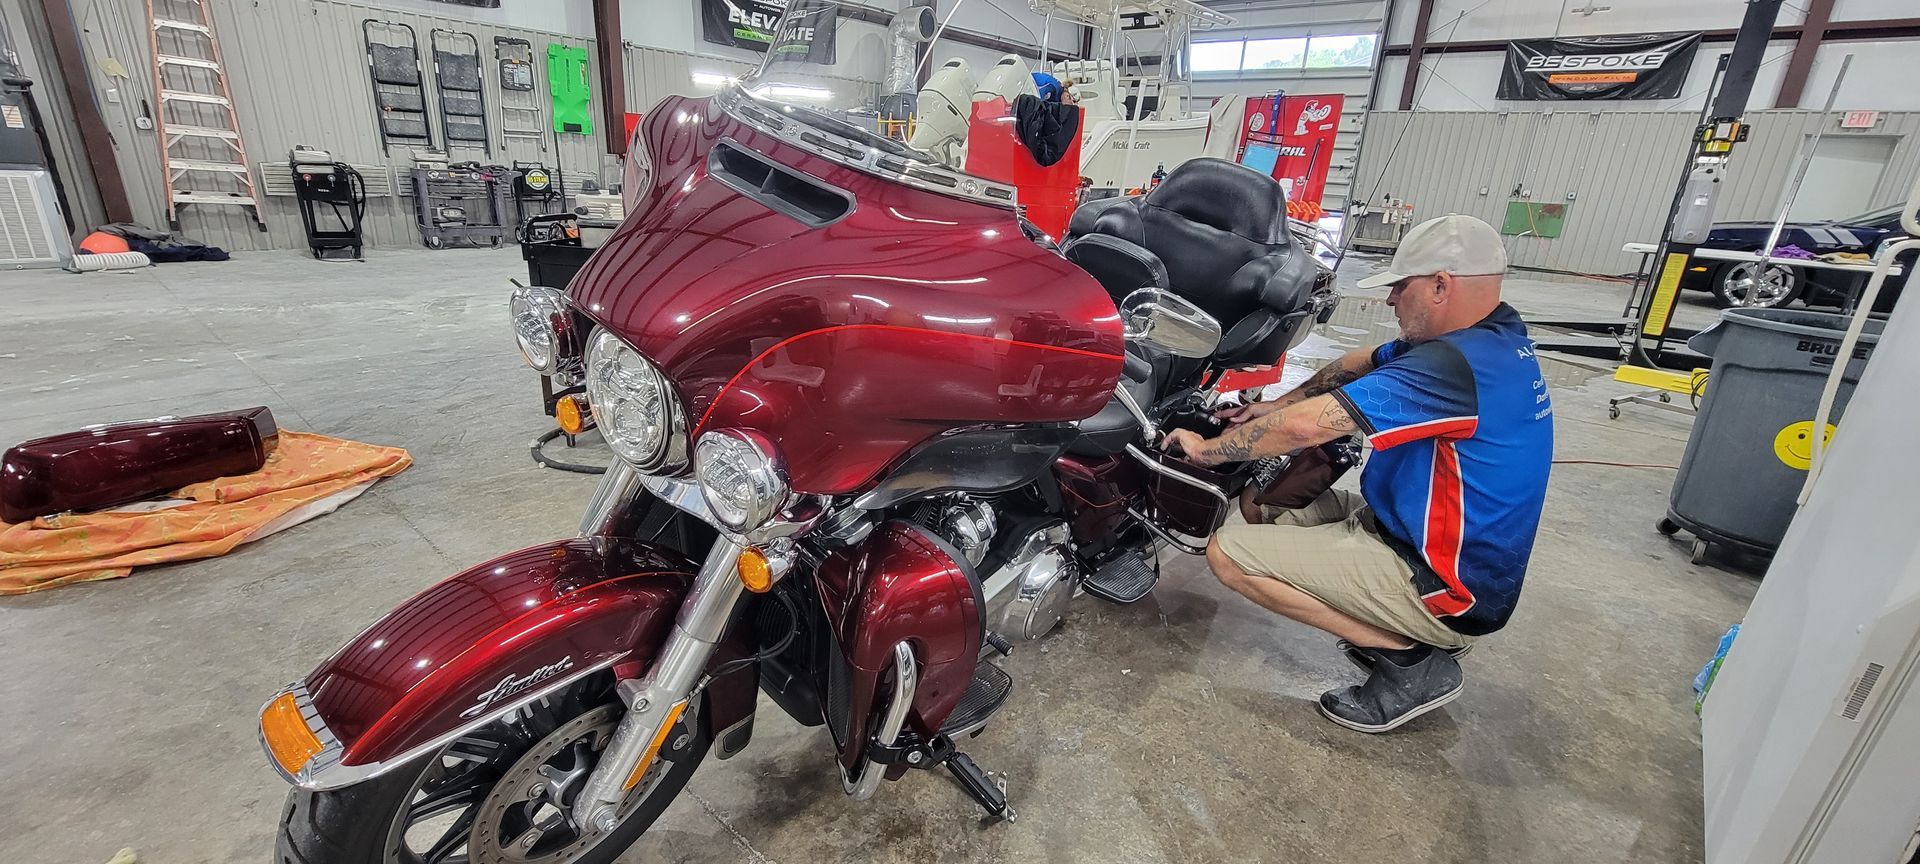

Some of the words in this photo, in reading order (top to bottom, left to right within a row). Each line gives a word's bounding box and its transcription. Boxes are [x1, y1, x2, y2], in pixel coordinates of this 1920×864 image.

[1526, 52, 1666, 69] BESPOKE
[1847, 112, 1874, 126] EXIT
[1796, 340, 1868, 360] BRUE
[459, 655, 574, 719] Limited
